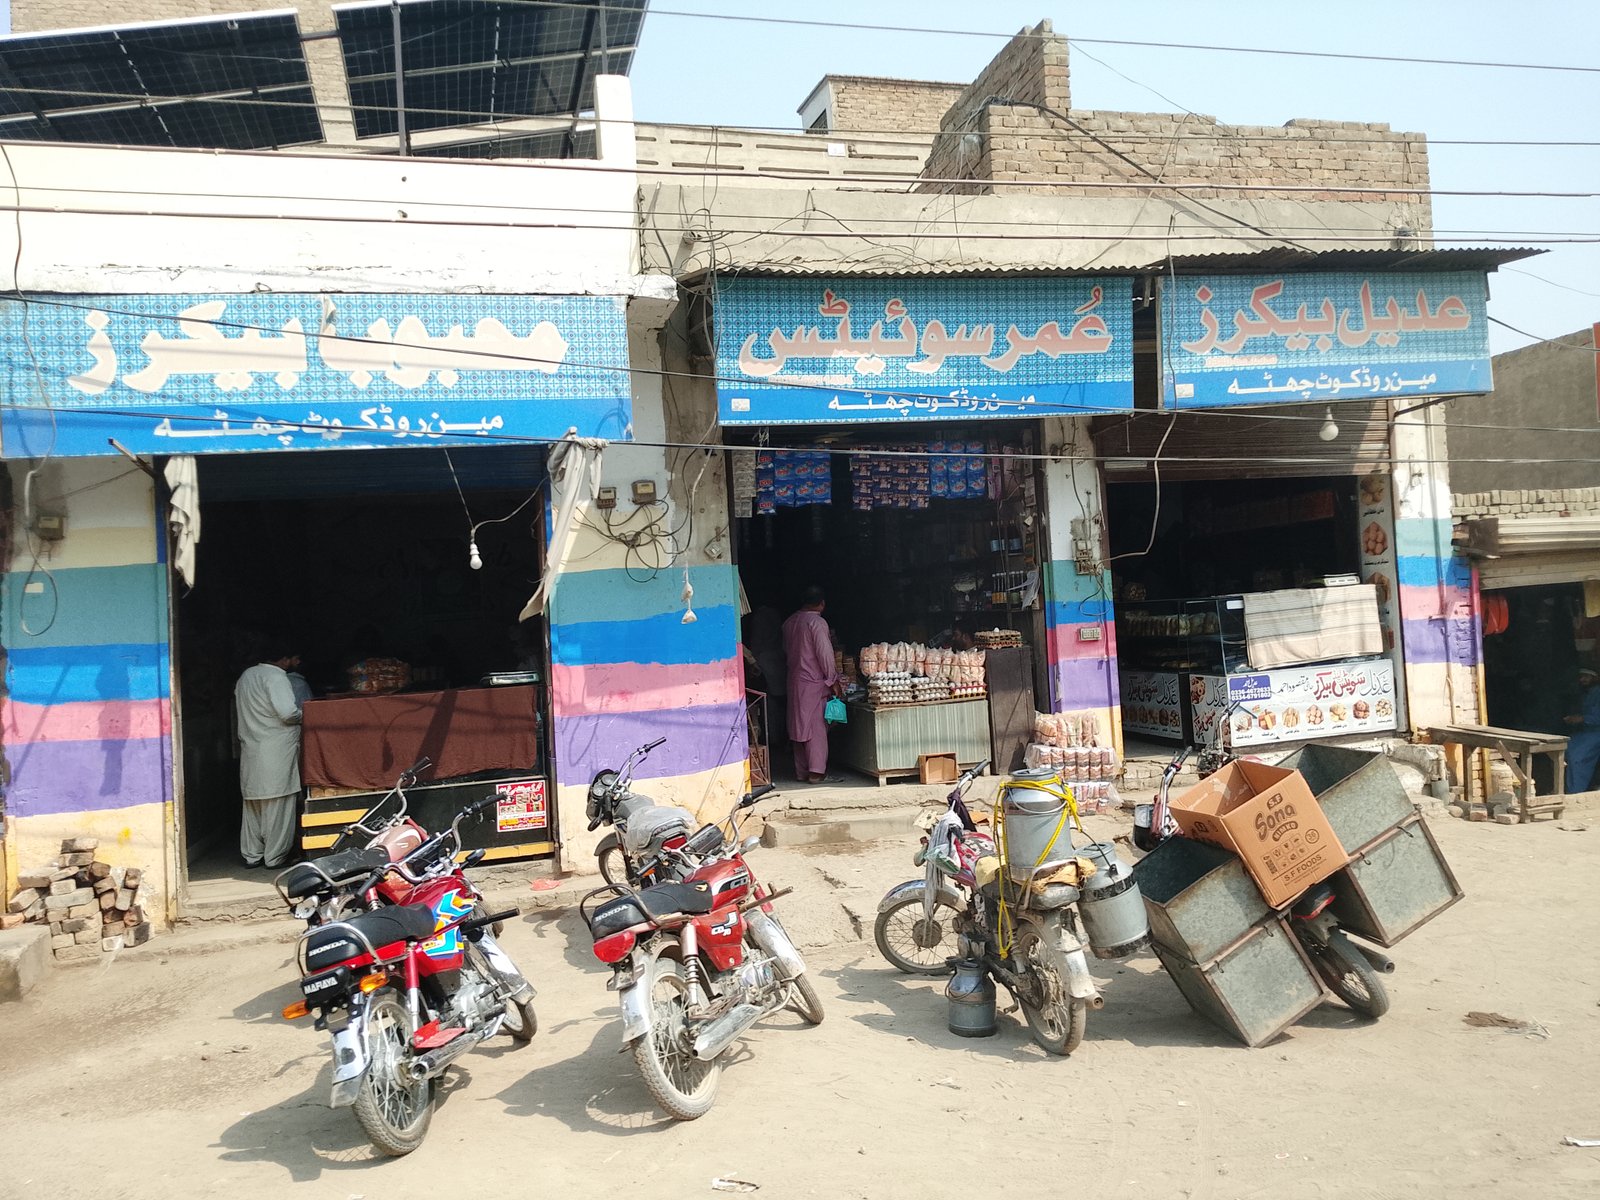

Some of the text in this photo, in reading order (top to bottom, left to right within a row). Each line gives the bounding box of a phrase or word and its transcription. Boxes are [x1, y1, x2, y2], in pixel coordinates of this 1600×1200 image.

[1181, 279, 1472, 354] عدیل بیکرز
[66, 301, 570, 394] محبوب بیکرز
[1227, 365, 1437, 399] مین روڈ کوٹ چھٹہ
[828, 386, 1036, 416] مین روڈ کوٹ چھٹہ
[153, 403, 505, 446] مین روڈ کوٹ چھٹہ
[1254, 804, 1296, 841] Sona
[1297, 854, 1322, 874] FOODS
[595, 904, 629, 921] HONDA
[308, 939, 348, 957] HONDA
